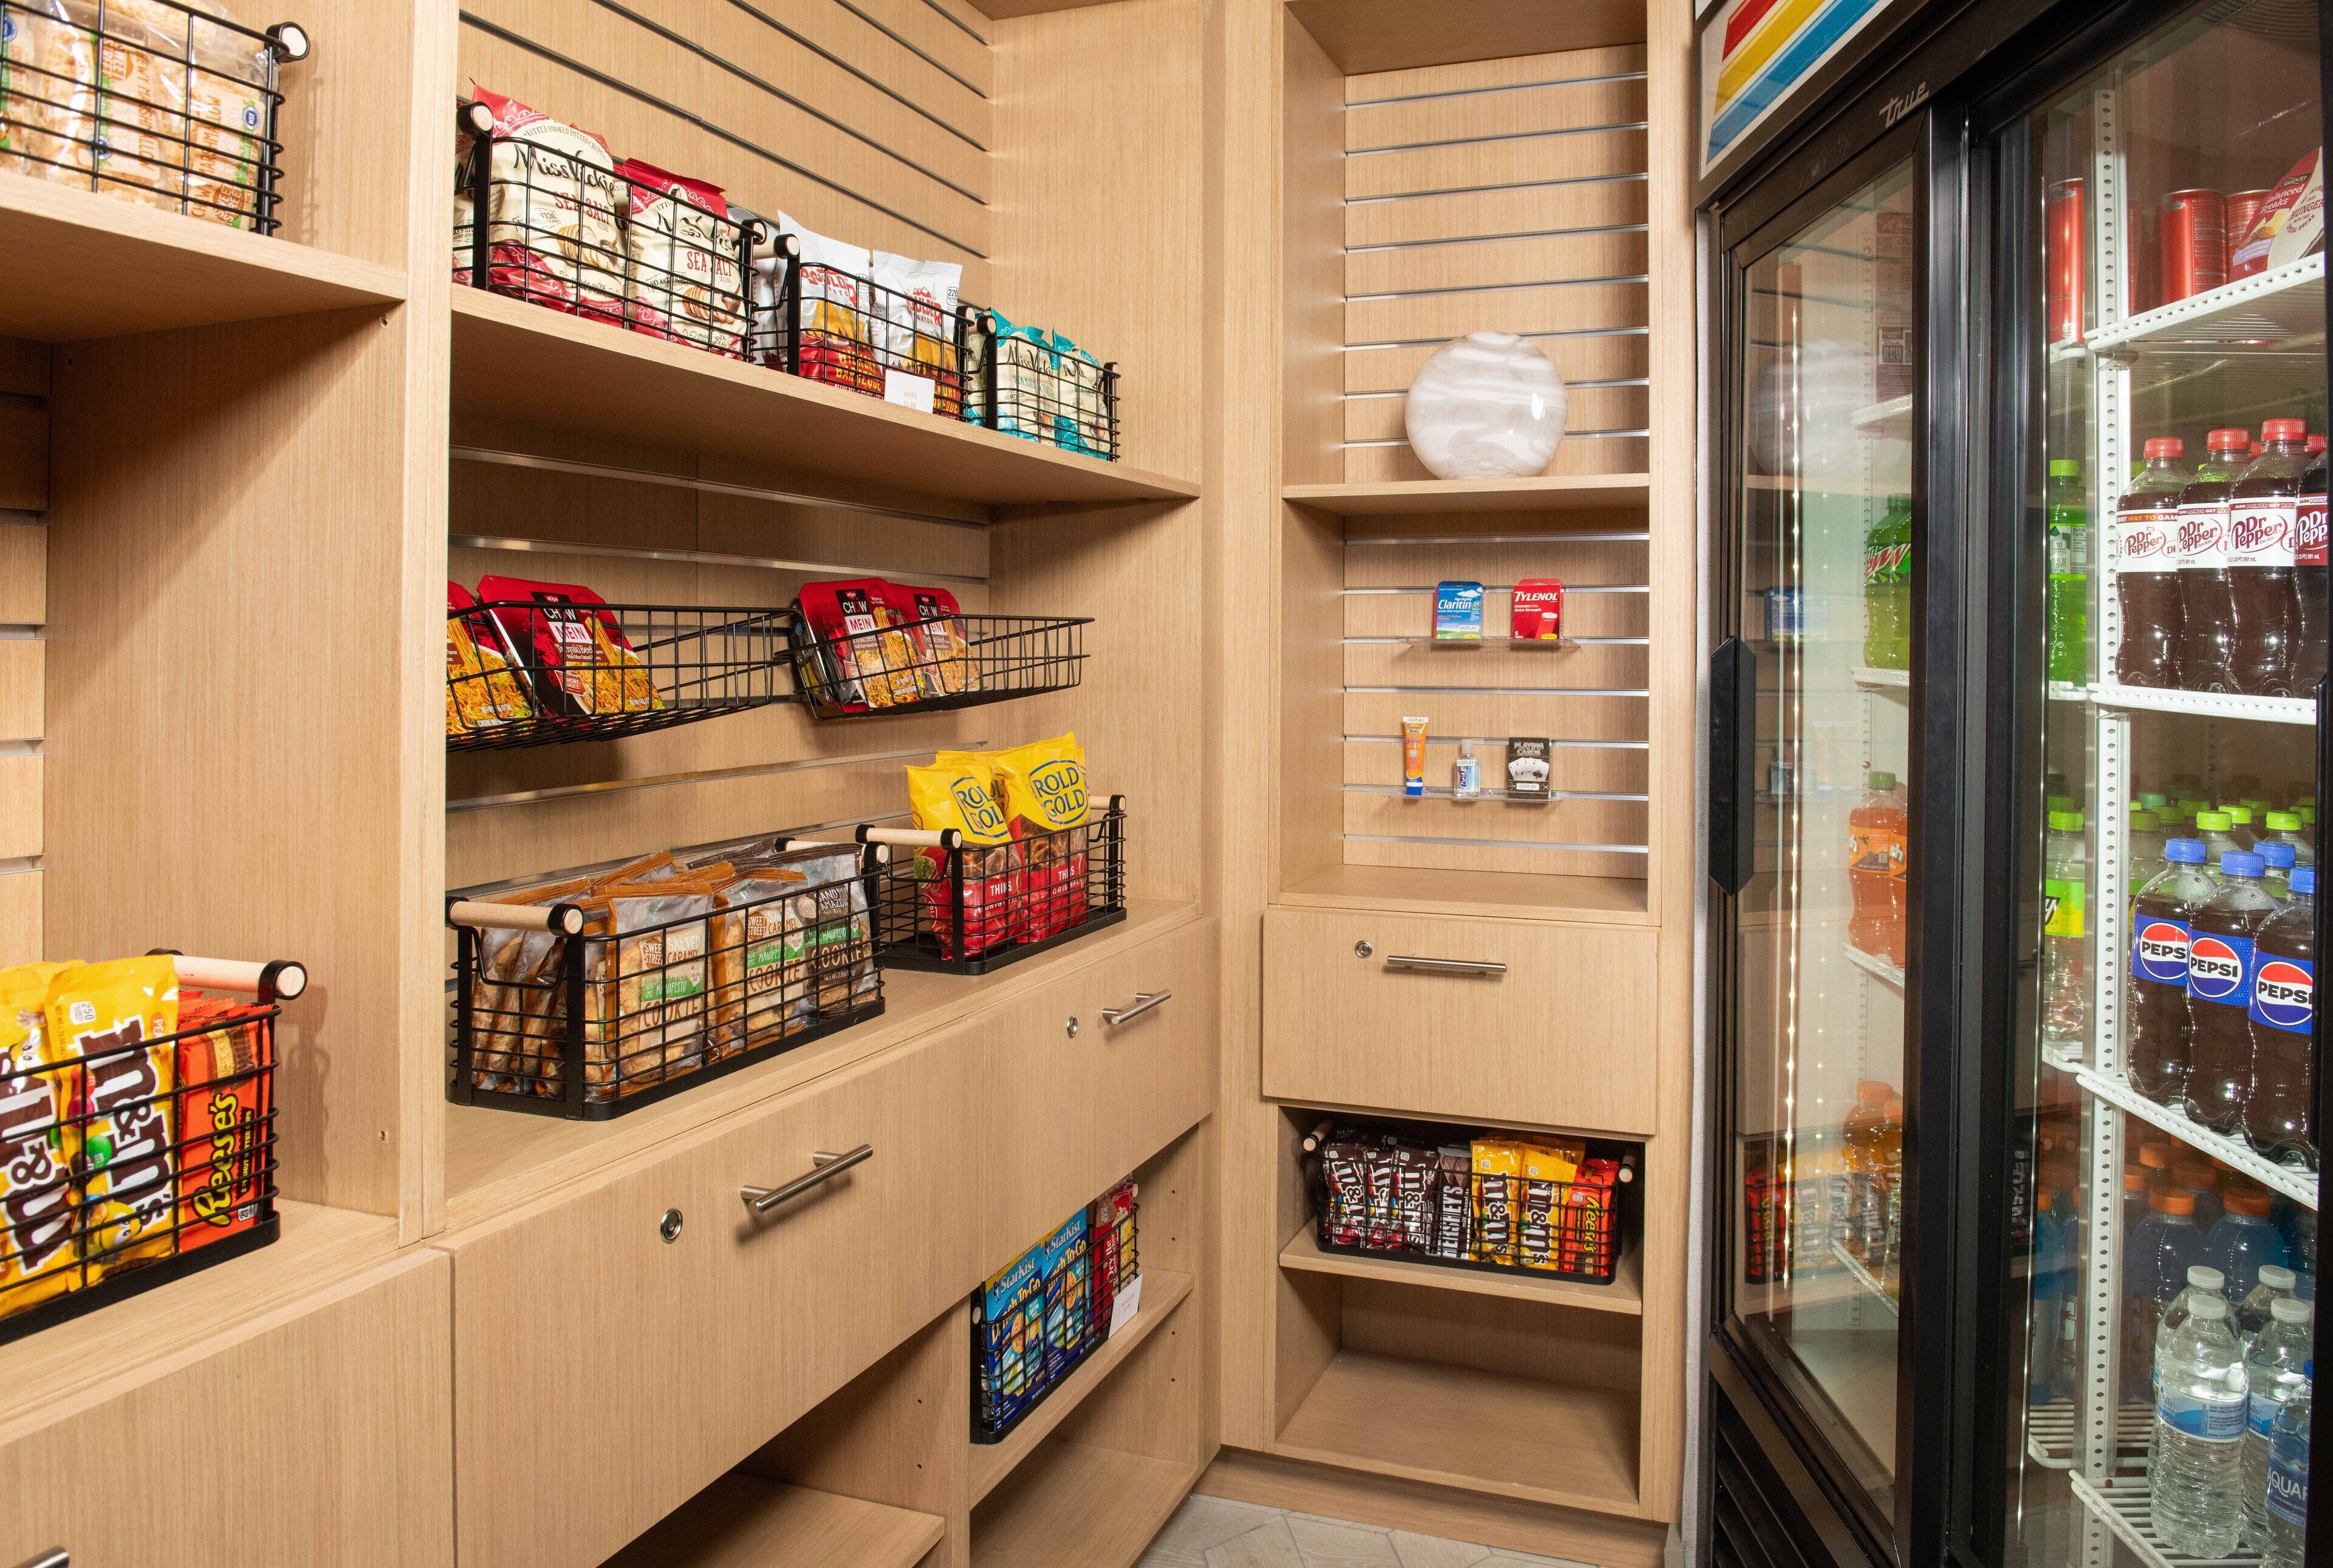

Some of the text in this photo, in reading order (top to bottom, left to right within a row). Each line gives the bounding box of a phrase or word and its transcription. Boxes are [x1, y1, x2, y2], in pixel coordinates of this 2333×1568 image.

[1879, 81, 1930, 129] true
[526, 125, 549, 137] KETTLE
[548, 125, 570, 137] COOKED
[569, 129, 589, 145] POTATO
[513, 143, 572, 179] Miss
[553, 191, 581, 211] SEA
[2265, 183, 2304, 205] Balanced
[2261, 198, 2290, 213] Breaks
[687, 251, 732, 277] SEA ALT
[948, 289, 958, 298] 220
[904, 391, 923, 399] CHIPS
[2187, 521, 2204, 537] Dr
[2246, 516, 2267, 533] Dr
[2309, 510, 2328, 530] Dr
[2136, 531, 2152, 545] Dr
[2177, 526, 2218, 553] Pepper
[2232, 520, 2283, 550] Pepper
[2297, 516, 2328, 547] Pepp
[2124, 534, 2163, 556] Pepper
[1437, 599, 1472, 610] Claritin
[1514, 591, 1558, 603] TYLENOL
[543, 606, 577, 620] CHW
[843, 601, 868, 614] CHOW
[919, 604, 937, 617] CHOW
[555, 625, 587, 640] MEIN
[849, 618, 872, 631] MEIN
[555, 643, 580, 655] Teiyaki
[1514, 742, 1544, 750] PLAYING
[1033, 766, 1080, 798] ROLD
[956, 784, 995, 809] ROL
[1042, 789, 1086, 818] GOLD
[970, 805, 1004, 830] GOL
[1058, 865, 1075, 881] THIS
[1052, 880, 1080, 895] ORIGNAL
[748, 916, 766, 926] SWEET
[748, 926, 767, 936] STREET
[644, 942, 662, 953] SWEE
[758, 948, 787, 963] MANIFESO
[2141, 940, 2187, 960] PEPS
[2190, 957, 2239, 978] PEPSI
[81, 1002, 95, 1021] 250
[193, 1093, 238, 1225] Reese's
[1437, 1185, 1464, 1258] HERSHEY'S
[1583, 1195, 1605, 1253] Reese's
[1051, 1219, 1081, 1253] StarKist
[1001, 1256, 1035, 1293] StarKist
